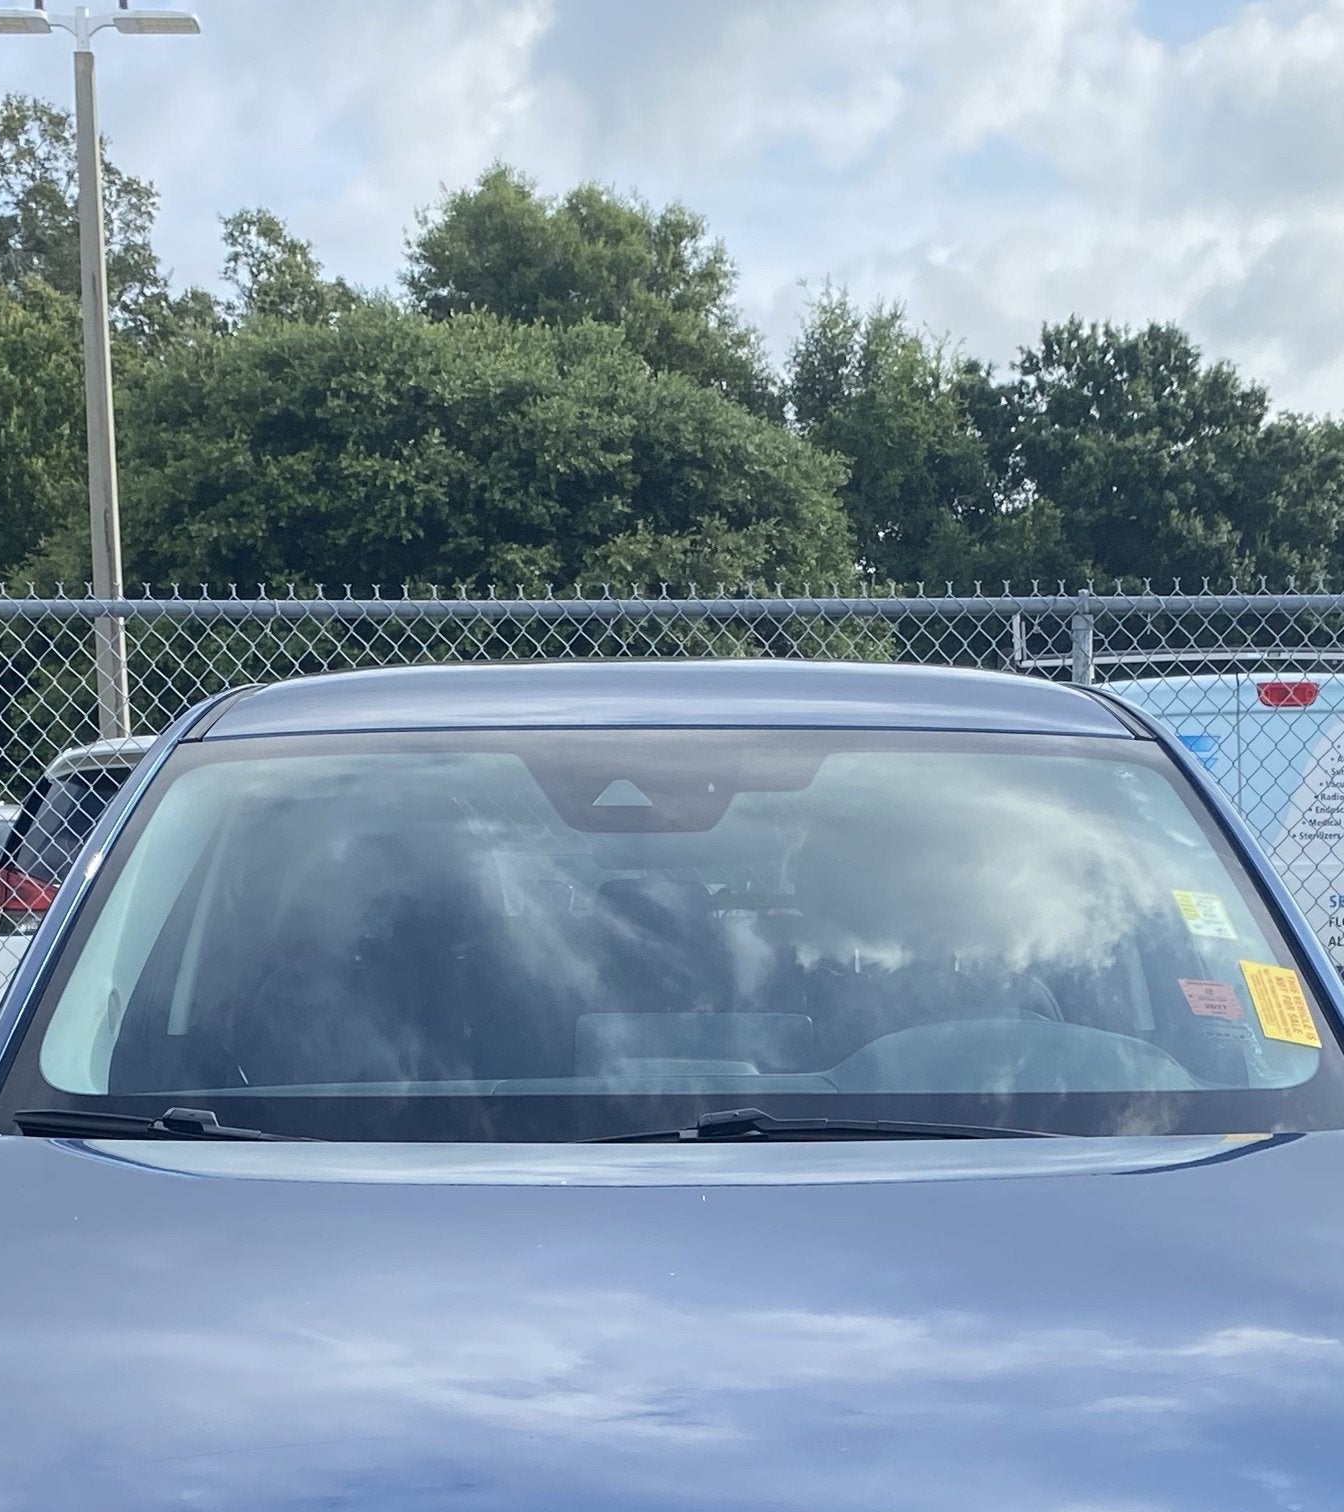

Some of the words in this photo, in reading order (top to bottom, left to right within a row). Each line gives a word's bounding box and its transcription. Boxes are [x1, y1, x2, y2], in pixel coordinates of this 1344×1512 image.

[1308, 818, 1341, 827] Medical
[1299, 832, 1341, 840] Sterilizers
[1275, 976, 1289, 992] NOT
[1282, 994, 1296, 1011] FOR
[1287, 976, 1299, 994] THIS
[1294, 996, 1314, 1030] VEHICLE
[1306, 1032, 1317, 1041] IS
[1288, 1012, 1303, 1035] SALE
